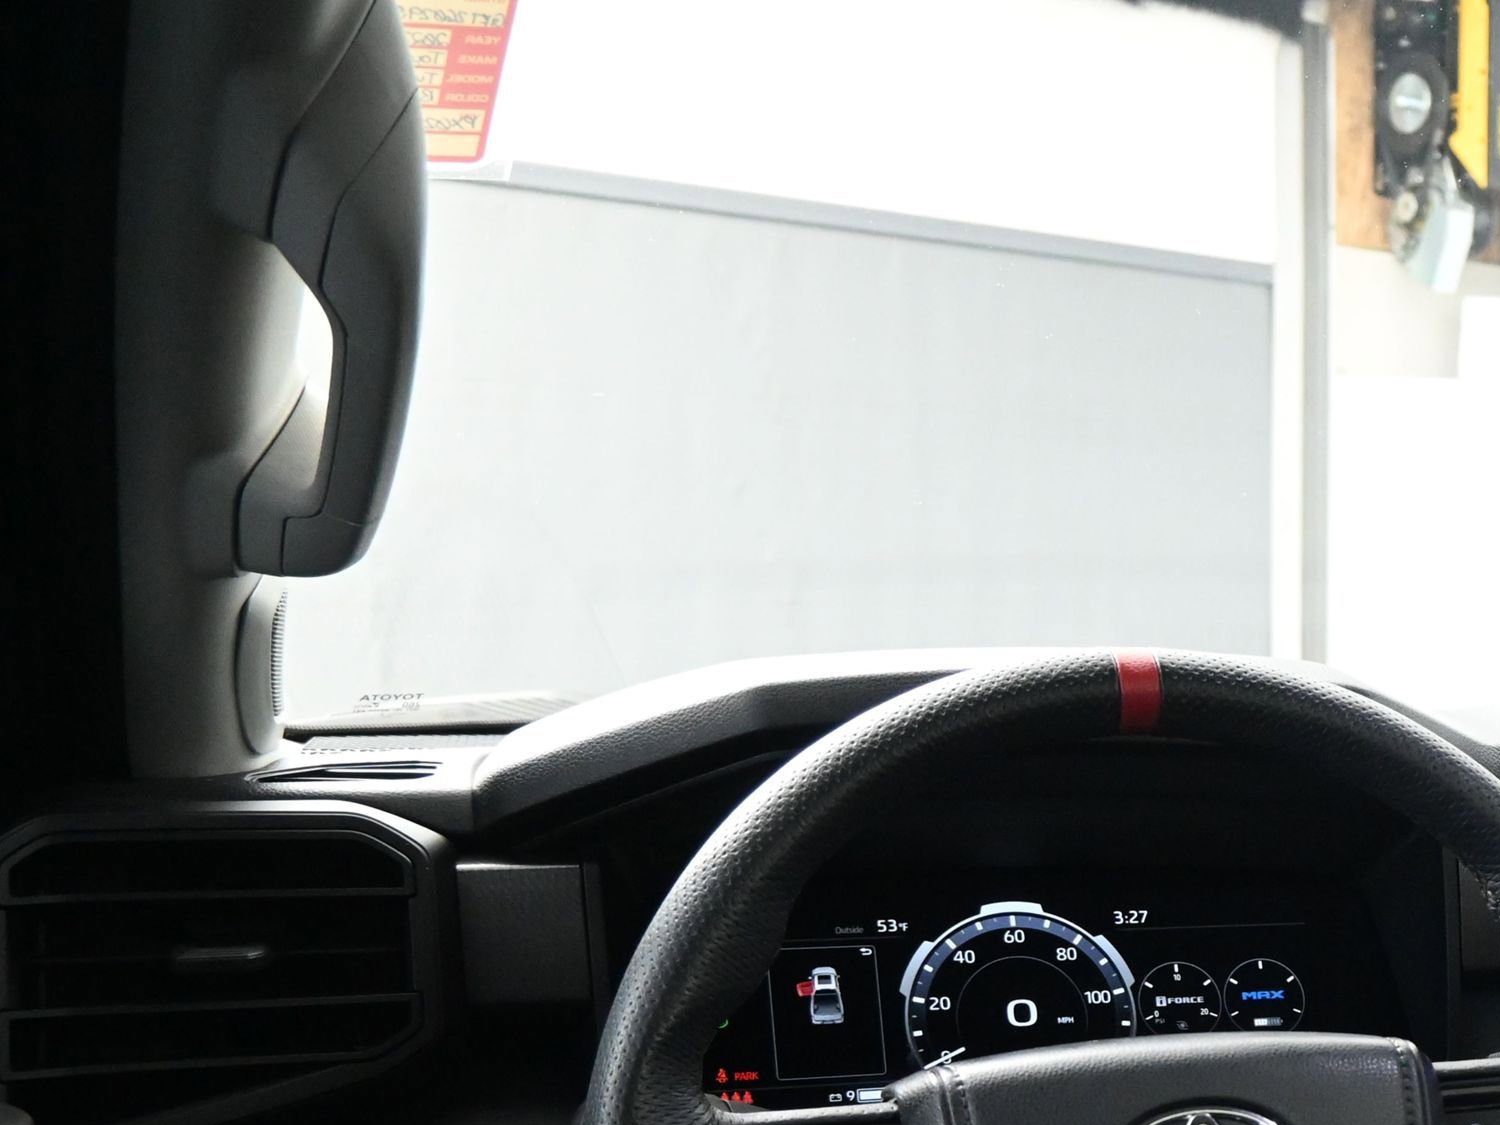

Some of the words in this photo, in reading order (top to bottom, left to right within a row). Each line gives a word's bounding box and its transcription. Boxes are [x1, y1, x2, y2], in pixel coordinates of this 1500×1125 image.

[1113, 910, 1148, 924] 3:27
[835, 926, 864, 935] Outside
[1003, 929, 1025, 944] 60
[953, 950, 976, 964] 40
[1056, 947, 1077, 961] 80
[1084, 990, 1111, 1004] 100
[1241, 990, 1285, 1000] MAX
[929, 996, 951, 1011] 20
[1006, 999, 1038, 1027] 0
[1200, 1008, 1209, 1016] 20
[1057, 1016, 1074, 1024] MPH
[734, 1072, 759, 1081] PARK
